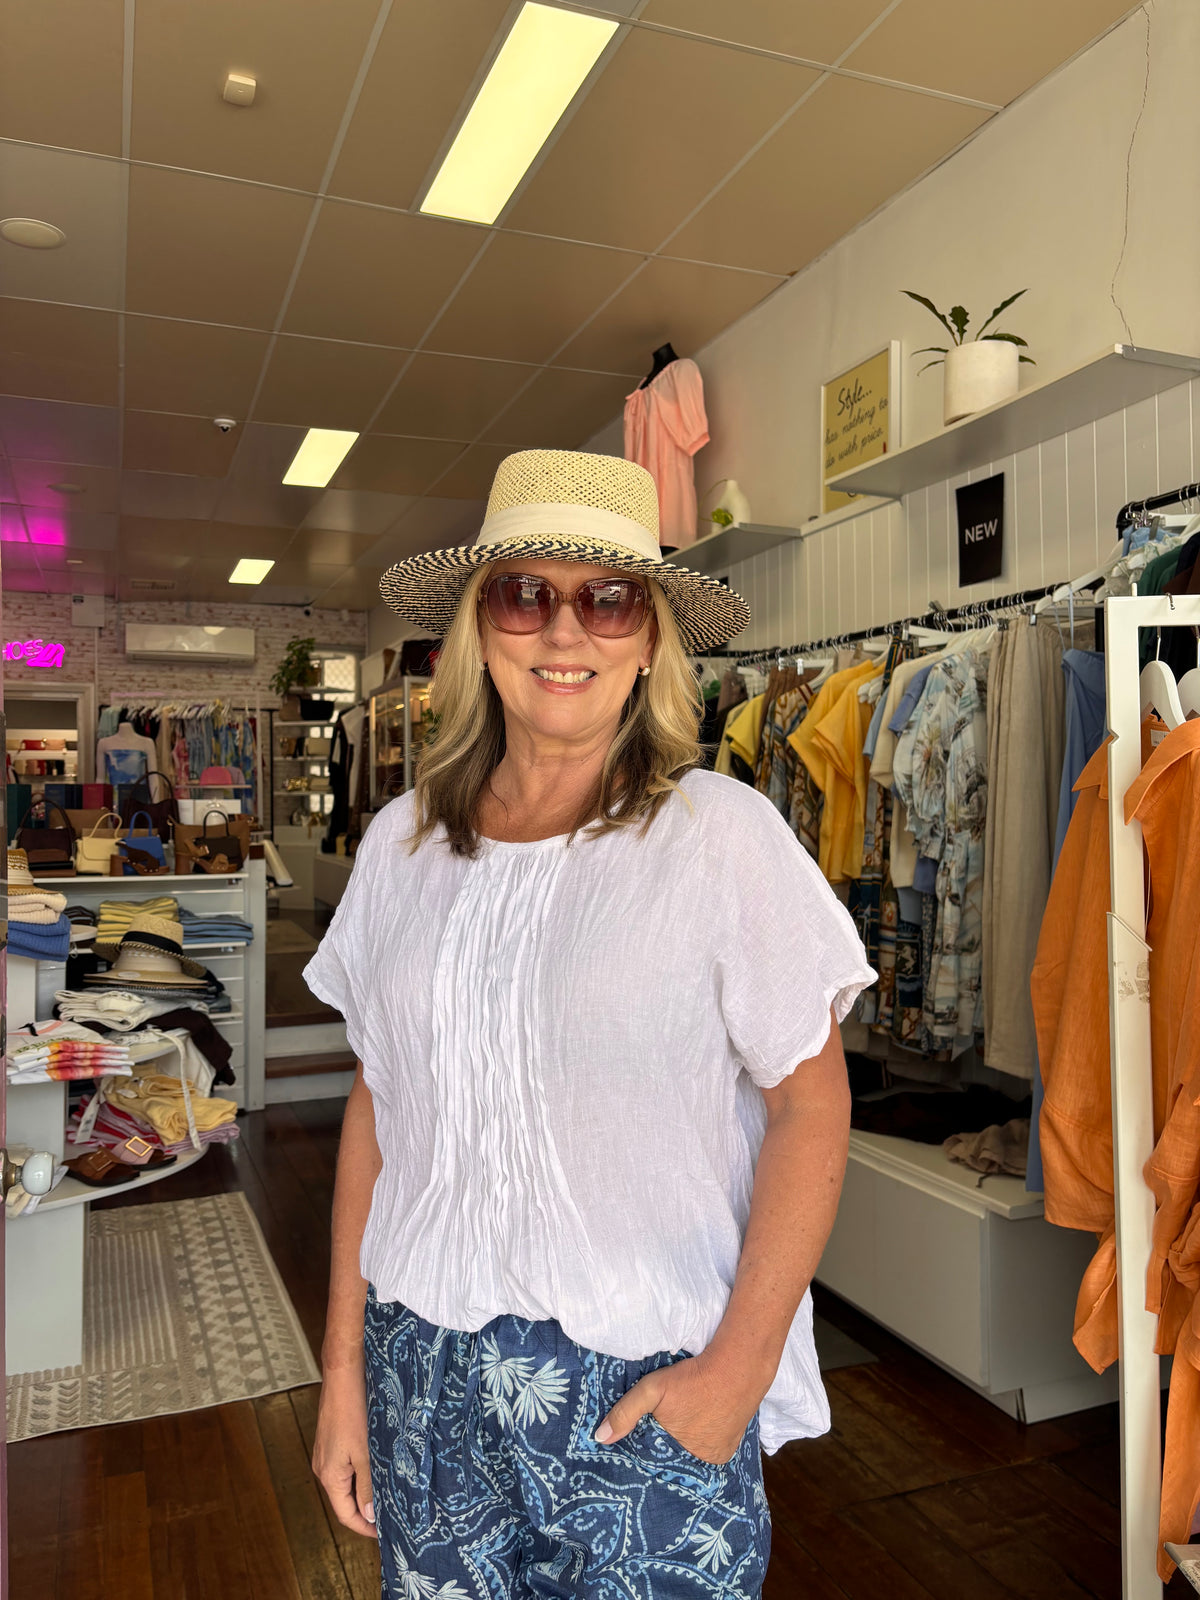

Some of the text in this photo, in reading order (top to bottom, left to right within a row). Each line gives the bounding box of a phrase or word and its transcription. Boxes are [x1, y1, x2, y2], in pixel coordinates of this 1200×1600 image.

[825, 398, 888, 445] has nothing to
[839, 434, 857, 460] with
[965, 518, 998, 545] NEW
